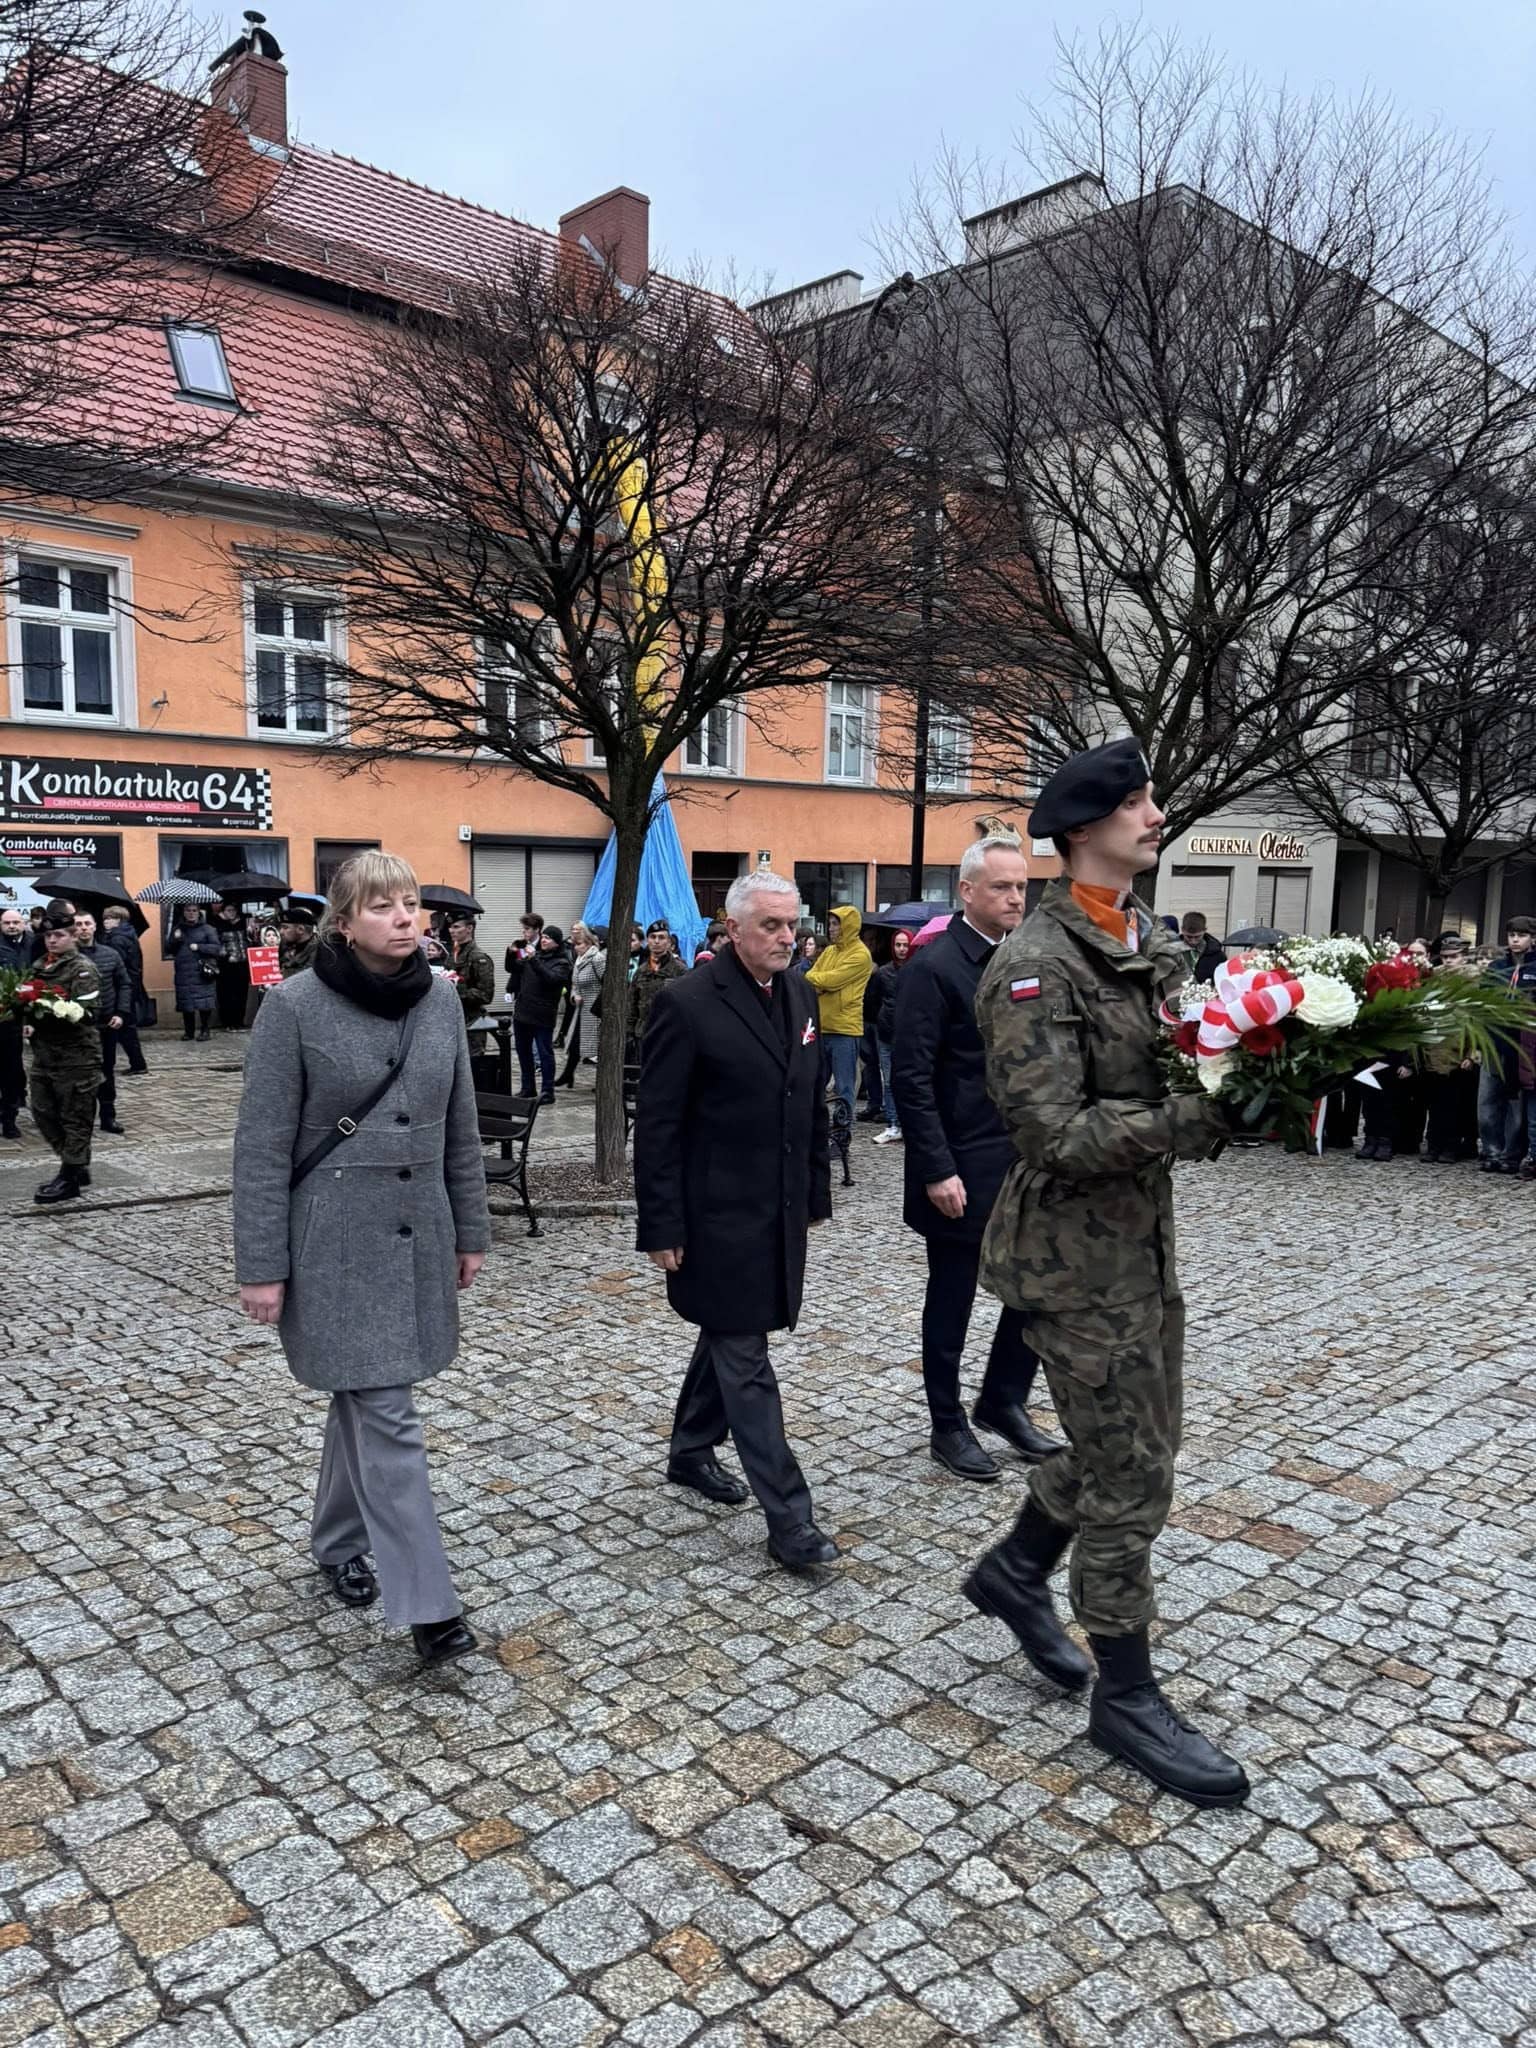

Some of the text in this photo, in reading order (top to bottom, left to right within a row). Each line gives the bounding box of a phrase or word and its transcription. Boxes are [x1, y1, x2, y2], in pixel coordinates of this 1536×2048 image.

[53, 799, 94, 807] CENTRUM
[1190, 832, 1304, 859] CUKIERNIA Oleńka
